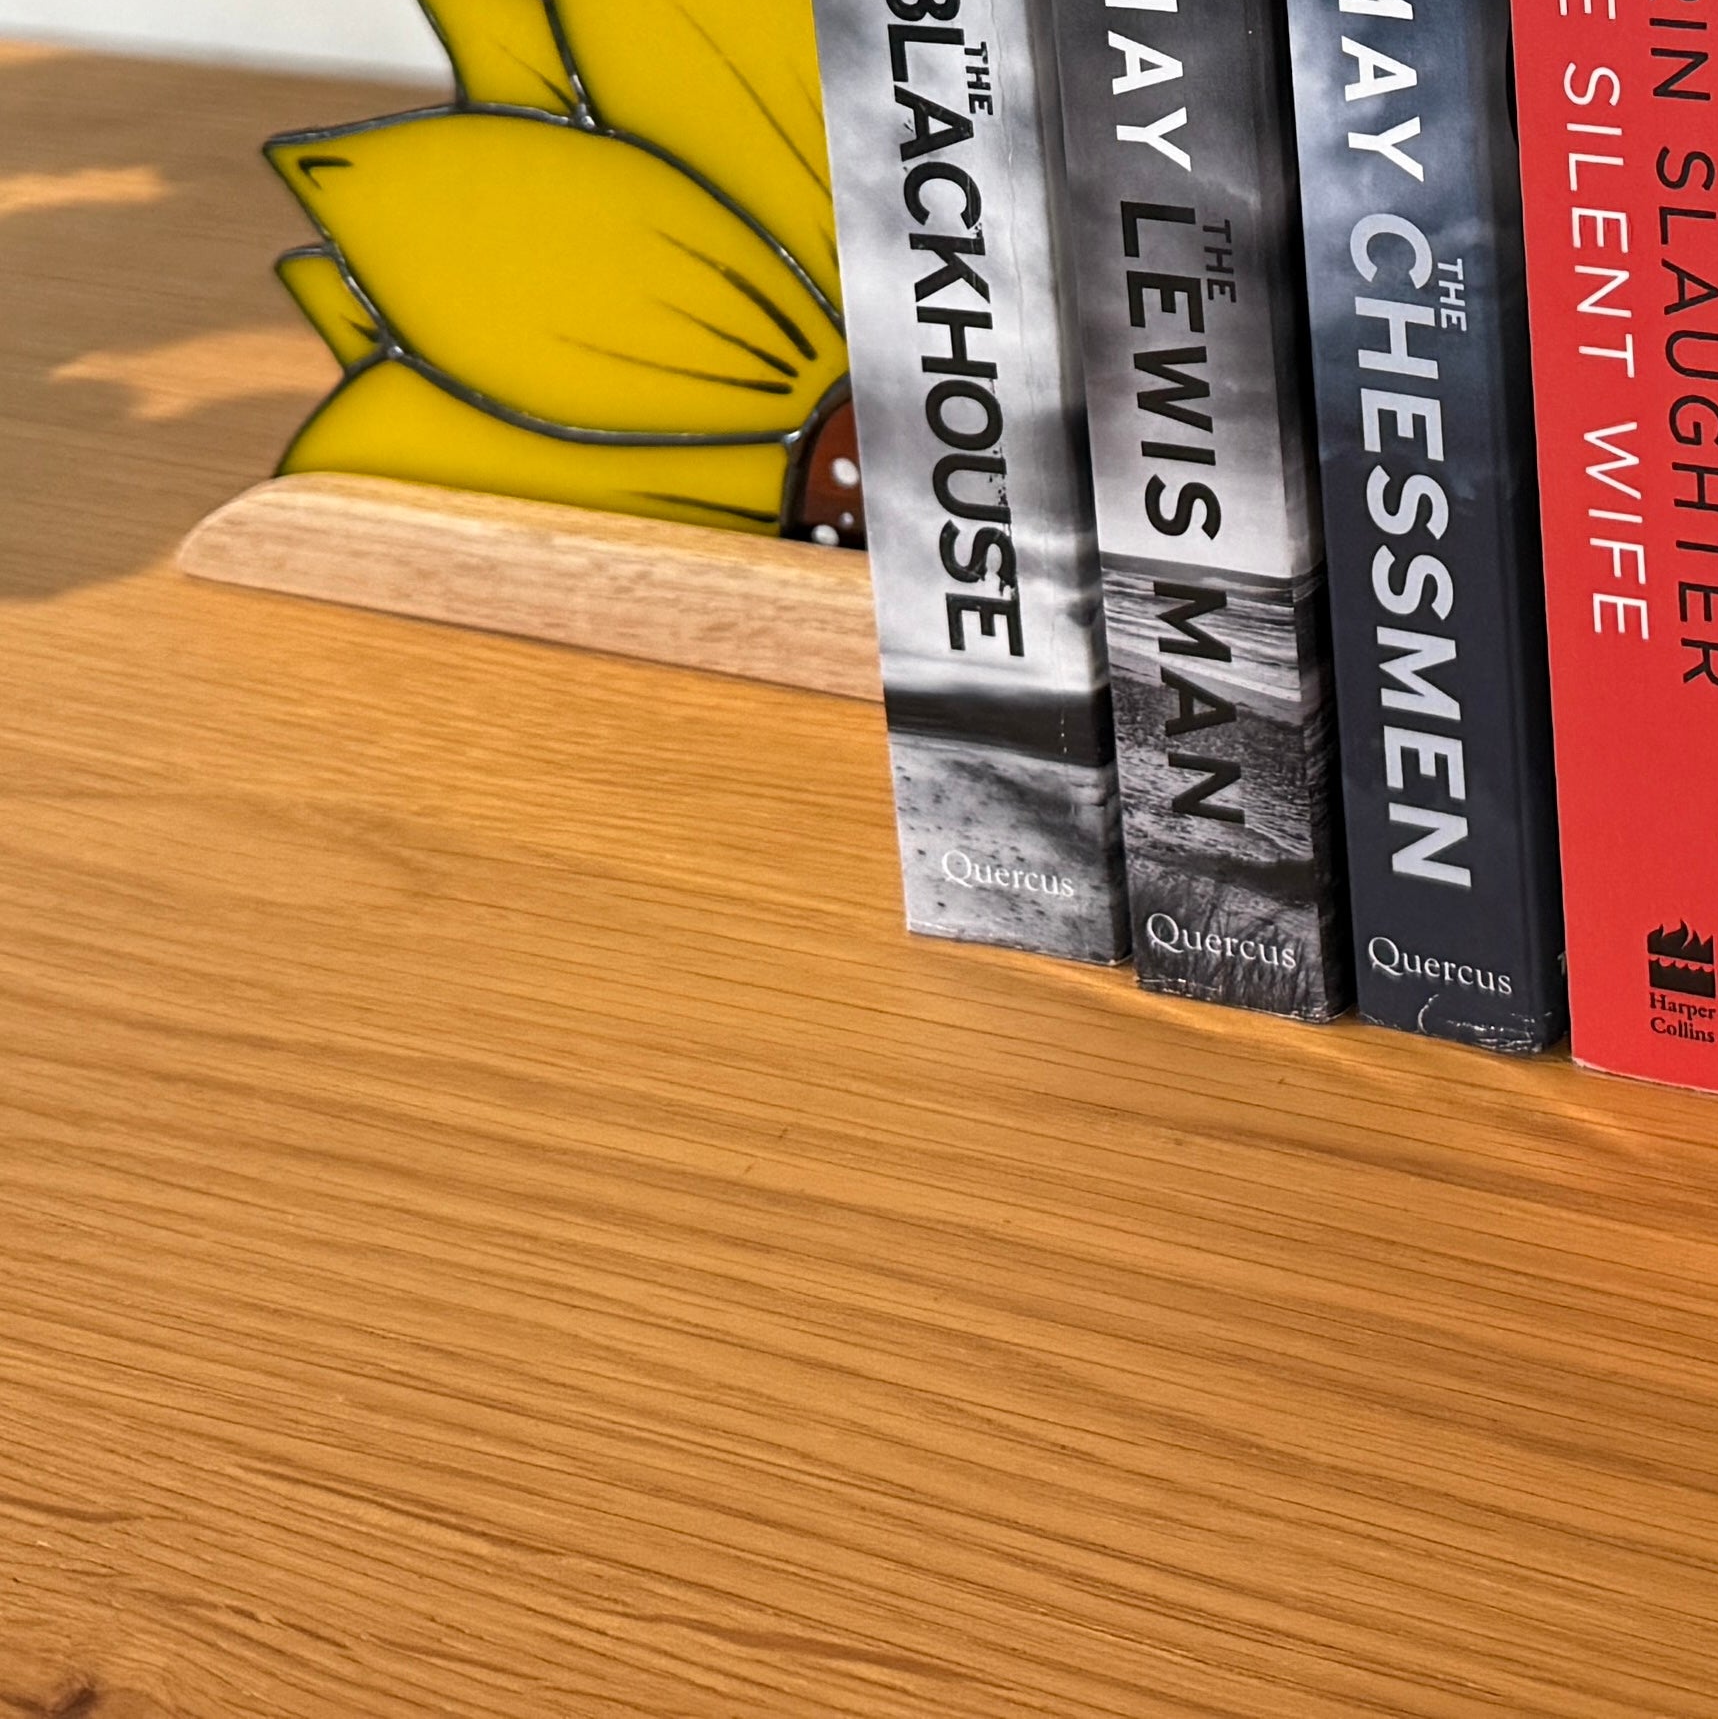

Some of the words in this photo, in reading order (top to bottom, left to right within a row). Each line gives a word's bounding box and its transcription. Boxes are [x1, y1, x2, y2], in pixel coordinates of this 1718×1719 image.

[963, 41, 993, 117] THE
[1563, 62, 1636, 379] SILENT
[1203, 219, 1236, 303] THE
[1437, 258, 1468, 333] THE
[1120, 200, 1222, 541] LEWIS
[1349, 212, 1473, 889] CHESSMEN
[1583, 421, 1650, 642] WIFE
[1153, 581, 1246, 826] MAN
[941, 850, 1075, 898] Quercus
[1146, 912, 1297, 970] Quercus
[1367, 935, 1513, 995] Quercus
[1649, 992, 1717, 1021] Harper
[1649, 1016, 1716, 1044] Collins
